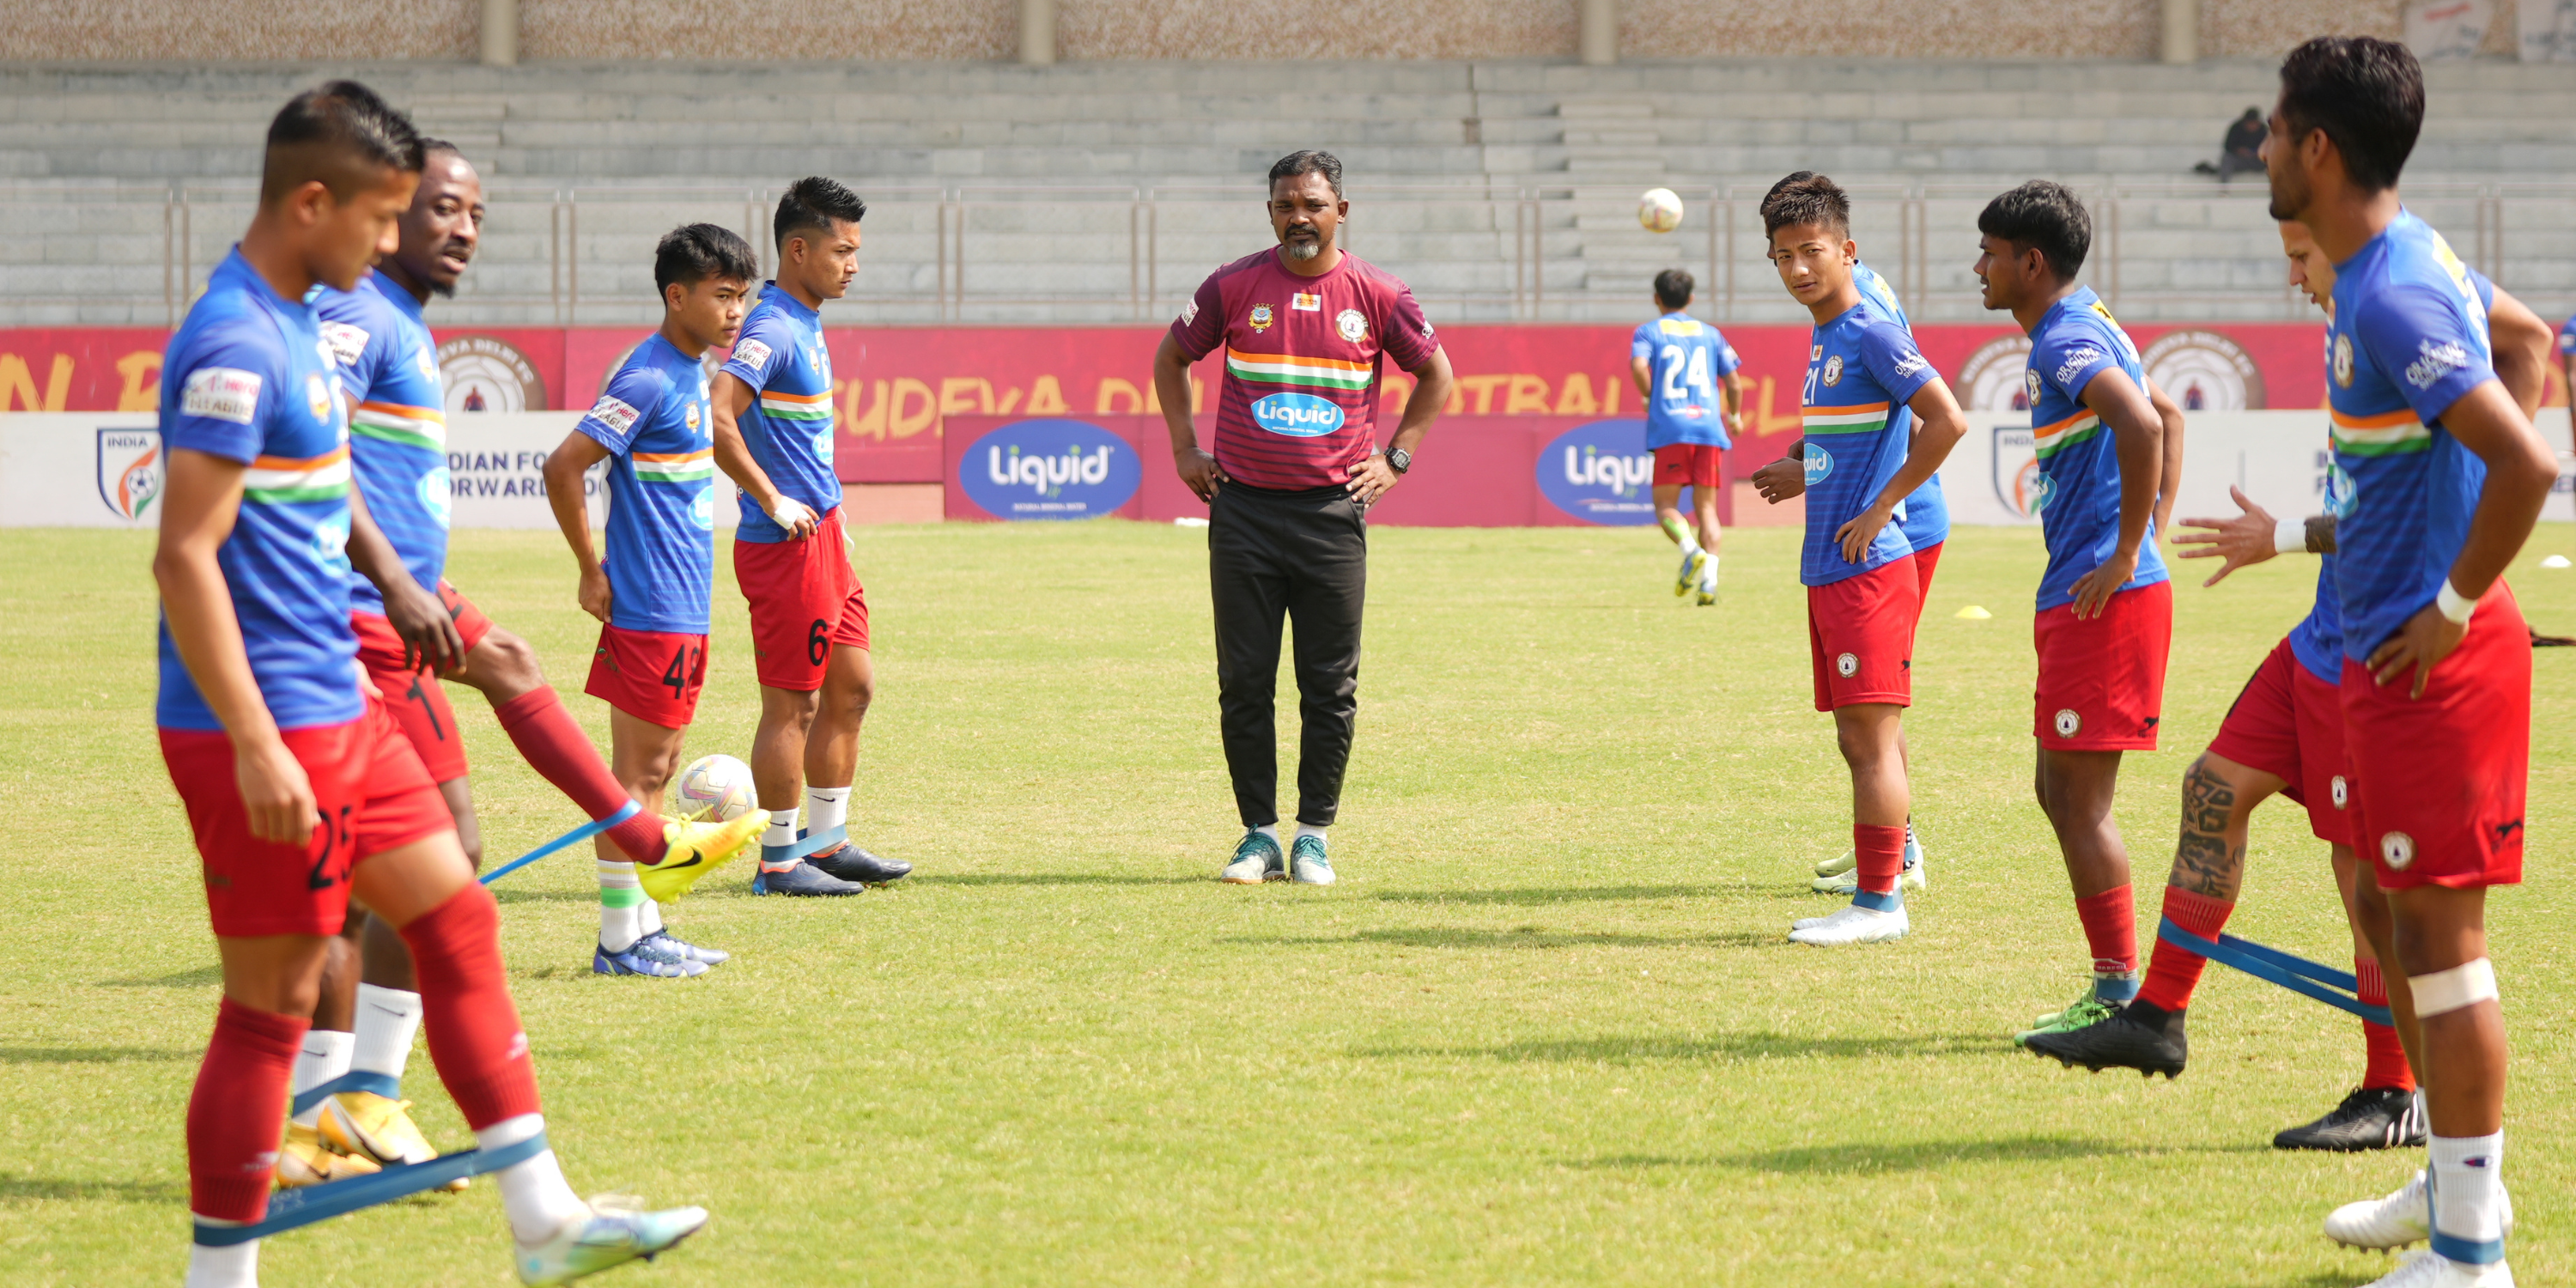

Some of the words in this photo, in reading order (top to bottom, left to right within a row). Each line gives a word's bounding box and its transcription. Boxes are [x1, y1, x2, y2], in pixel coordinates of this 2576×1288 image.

[751, 343, 769, 359] Hero
[1662, 344, 1711, 398] 24
[1802, 367, 1820, 405] 21
[617, 407, 636, 422] Hero
[1257, 400, 1338, 427] Liquid
[108, 436, 149, 447] INDIA
[989, 445, 1109, 495] Liquid
[809, 618, 829, 666] 6
